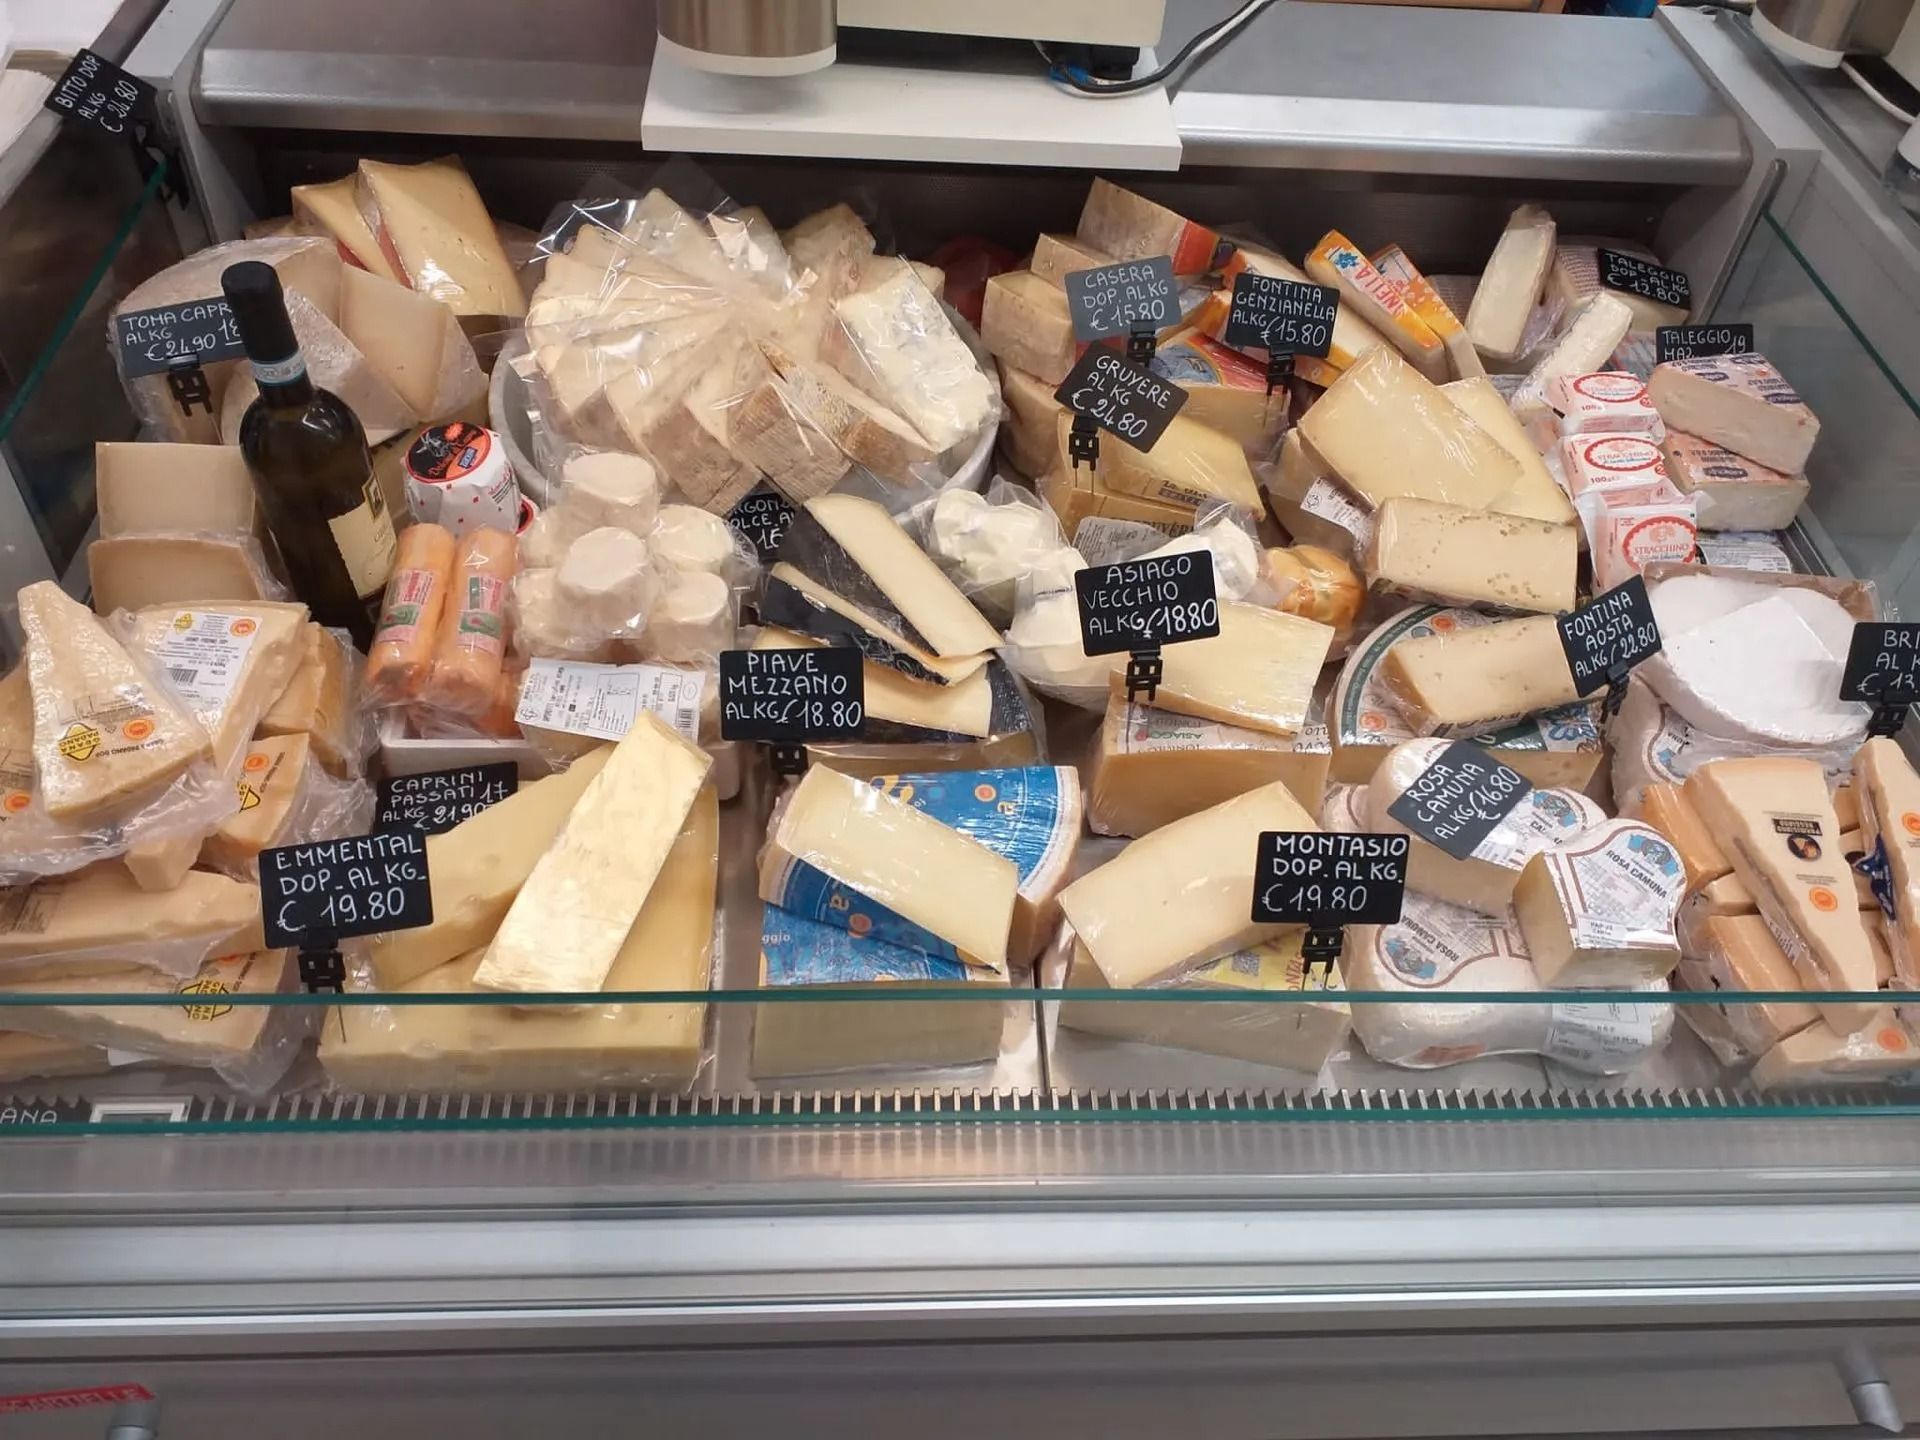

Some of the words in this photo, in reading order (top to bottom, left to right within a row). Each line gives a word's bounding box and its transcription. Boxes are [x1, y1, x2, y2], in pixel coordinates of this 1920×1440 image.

[55, 75, 87, 108] BITTO
[78, 55, 101, 79] DOP
[1084, 265, 1155, 289] CASERA
[1604, 252, 1686, 285] TALEGGIO
[1251, 276, 1323, 304] FONTINA
[1628, 279, 1681, 305] 12.80
[122, 311, 178, 331] TOMA
[1236, 291, 1336, 323] GENZIANELLA
[1661, 328, 1732, 346] TALEGGIO
[1096, 355, 1171, 409] GRUYERE
[1106, 556, 1192, 585] ASIAGO
[1083, 581, 1179, 610] VECCHIO
[1564, 591, 1633, 641] FONTINA
[1585, 613, 1634, 652] AOSTA
[747, 652, 819, 675] PIAVE
[728, 674, 848, 697] MEZZANO
[391, 771, 483, 793] CAPRINI
[1406, 764, 1454, 802] ROSA
[1417, 762, 1485, 822] CAMUNA
[391, 786, 475, 808] PASSATI
[276, 834, 422, 870] EMMENTAL
[1276, 835, 1408, 858] MONTASIO
[1335, 861, 1364, 880] AL
[1605, 849, 1630, 874] ROSA
[1630, 867, 1668, 900] CAMUNA
[320, 887, 405, 928] 19.80
[1435, 940, 1461, 963] ROSA
